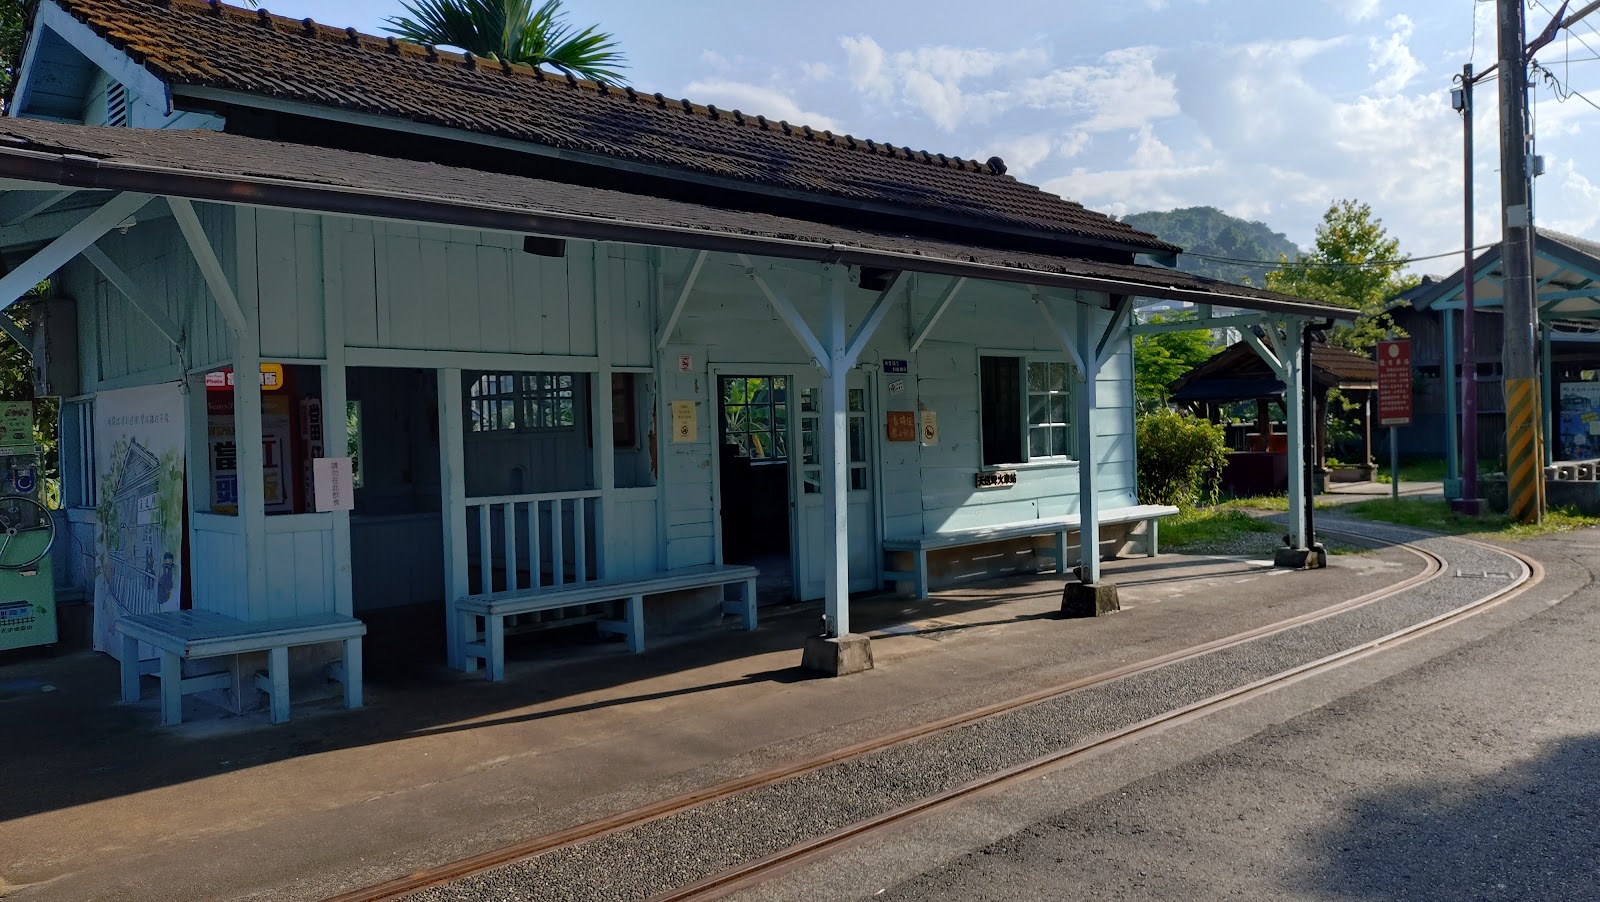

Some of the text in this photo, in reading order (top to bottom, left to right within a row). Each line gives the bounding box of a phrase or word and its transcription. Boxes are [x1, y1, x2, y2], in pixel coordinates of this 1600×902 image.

[330, 462, 340, 506] 請勿在此飲食
[977, 473, 1017, 486] 天送埤火車站
